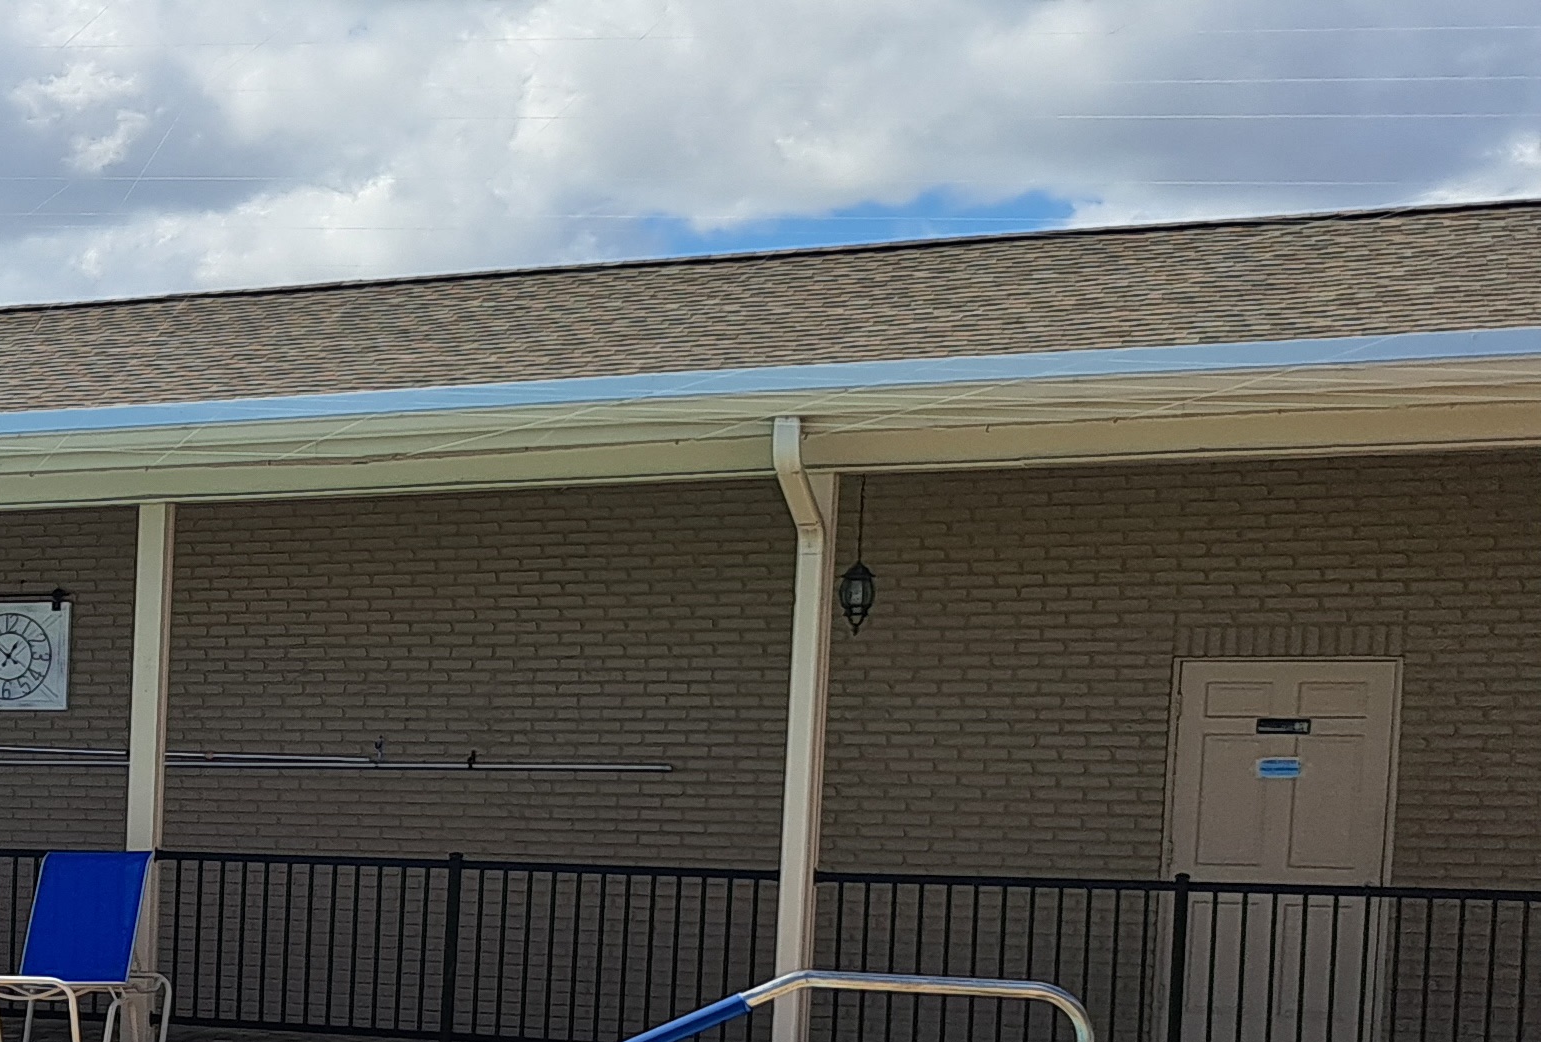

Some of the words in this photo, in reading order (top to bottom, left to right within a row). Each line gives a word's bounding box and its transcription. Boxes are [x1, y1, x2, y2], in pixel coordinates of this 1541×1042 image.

[5, 613, 19, 633] 12
[27, 632, 48, 647] 2
[31, 651, 50, 662] 3
[28, 668, 45, 681] 4
[1, 680, 12, 699] 6
[17, 676, 32, 695] 5
